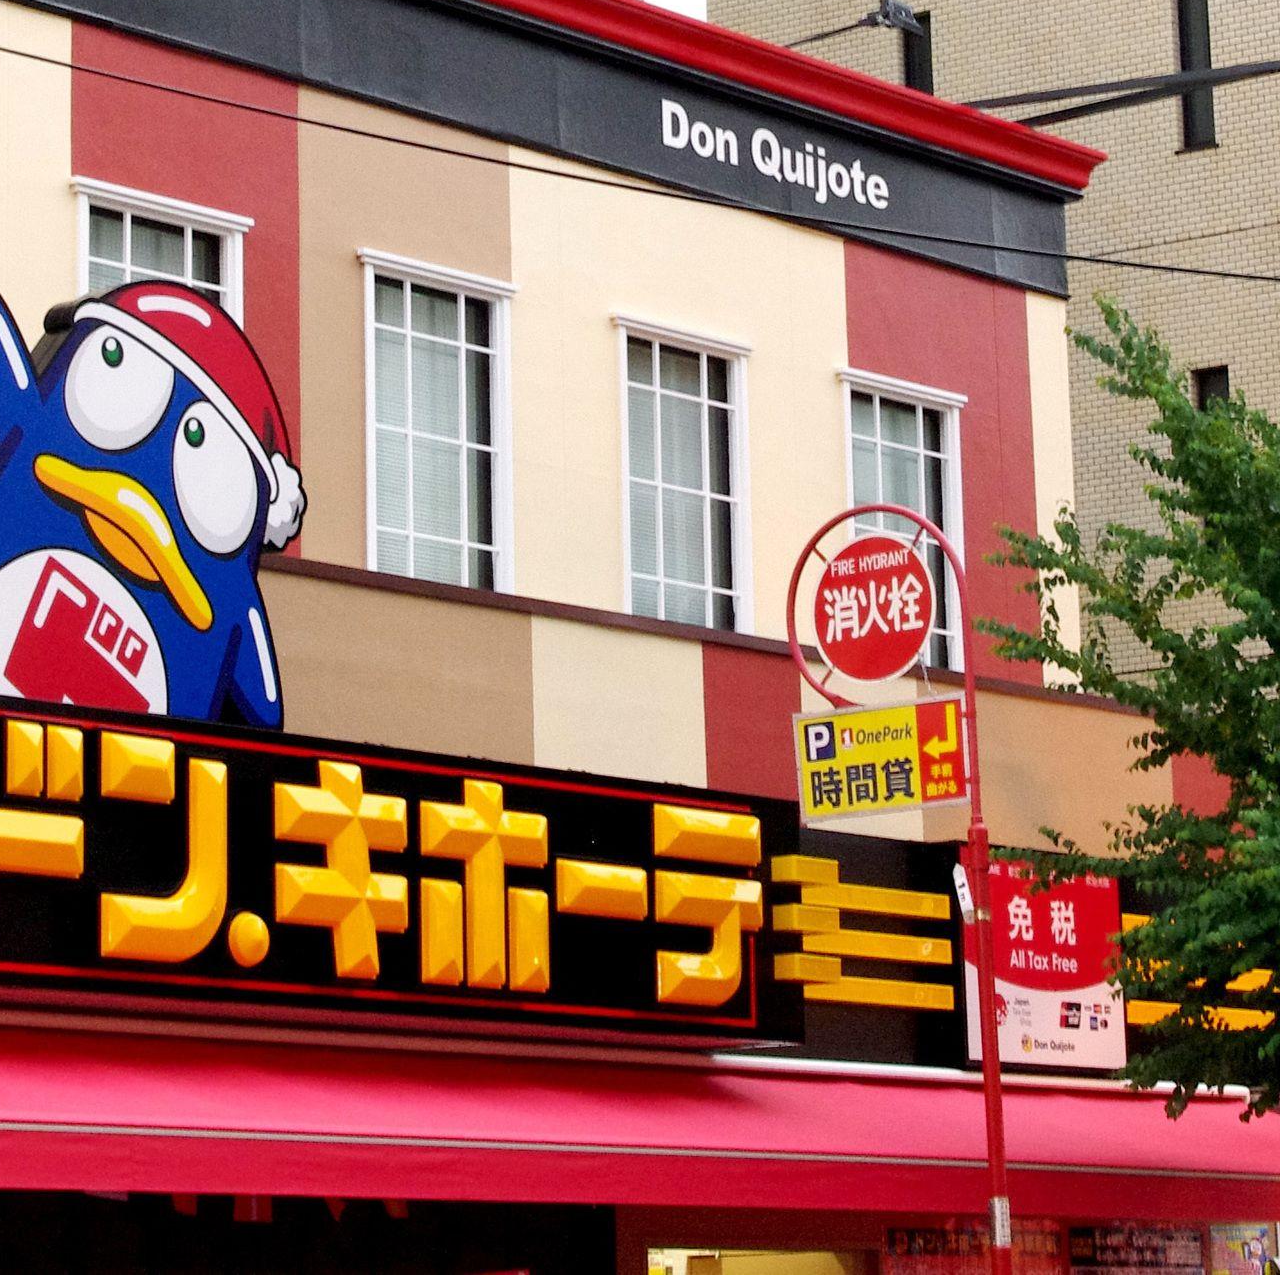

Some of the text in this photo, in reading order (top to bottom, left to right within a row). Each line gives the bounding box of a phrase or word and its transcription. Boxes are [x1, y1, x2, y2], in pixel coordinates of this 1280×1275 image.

[661, 98, 889, 210] Don Quijote
[831, 548, 910, 577] FIRE HYDRANT
[823, 573, 924, 644] 消火栓
[808, 725, 830, 761] P
[856, 723, 912, 745] OnePark
[811, 757, 915, 808] 時間貸
[1007, 894, 1077, 946] 免税
[1010, 949, 1078, 973] All Tax Free
[1034, 1038, 1048, 1050] Don
